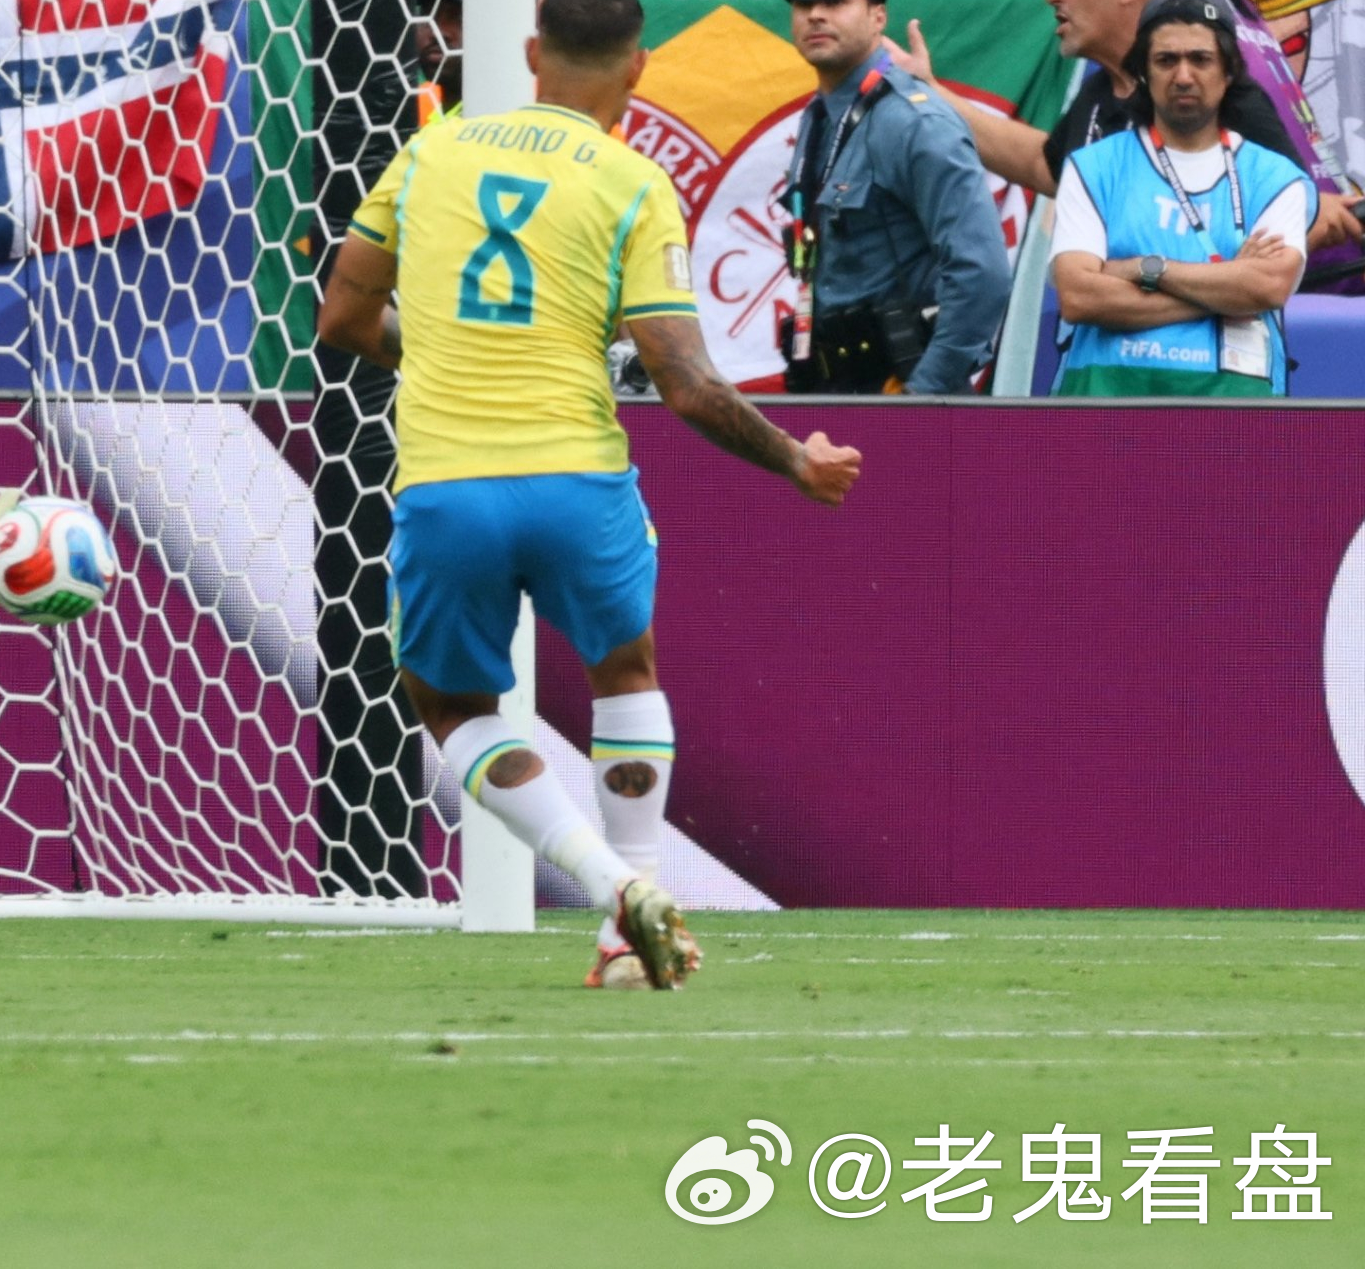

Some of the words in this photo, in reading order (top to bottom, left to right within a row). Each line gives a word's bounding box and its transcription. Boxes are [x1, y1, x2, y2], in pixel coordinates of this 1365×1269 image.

[456, 122, 568, 153] BRUNO
[572, 141, 599, 169] G.
[455, 171, 552, 327] 8
[1120, 338, 1211, 364] FIFA.com
